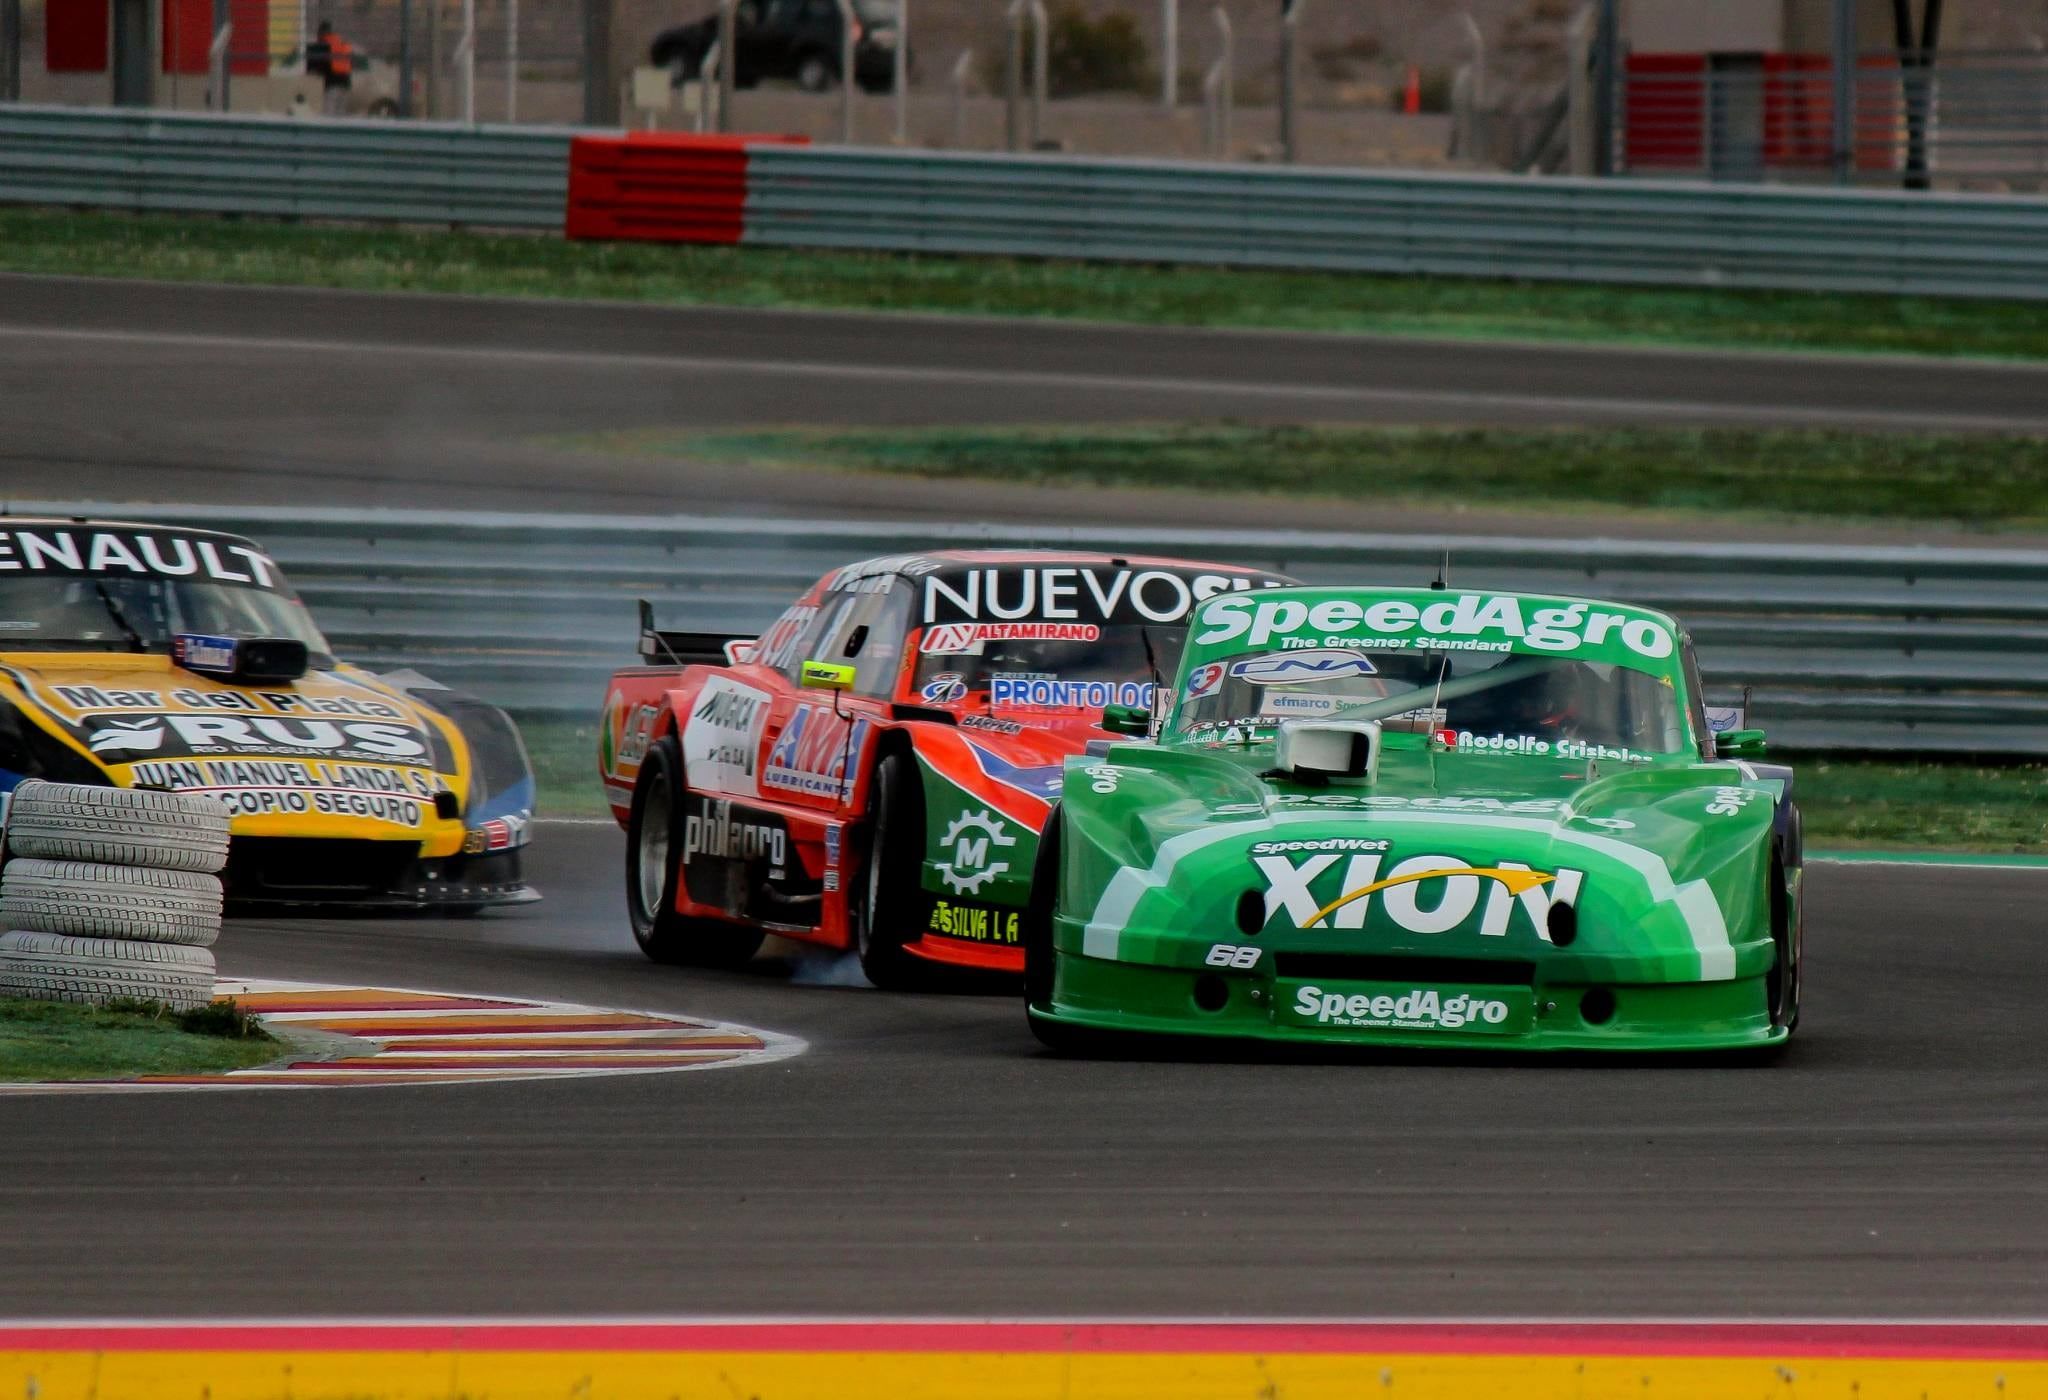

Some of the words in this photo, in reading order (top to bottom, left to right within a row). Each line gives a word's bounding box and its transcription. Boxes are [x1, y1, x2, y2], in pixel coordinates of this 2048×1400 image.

[975, 623, 1100, 641] ALTAMIRANO
[1194, 595, 1674, 659] SpeedAgro
[1281, 636, 1318, 649] The
[1324, 635, 1411, 649] Greener
[1414, 636, 1513, 653] Standard
[52, 686, 163, 708] Mar
[171, 688, 260, 711] del
[258, 691, 405, 719] Plata
[164, 716, 425, 756] RUS
[1457, 731, 1550, 753] Rodolfo
[132, 761, 205, 789] JUAN
[206, 761, 321, 787] MANUEL
[319, 764, 410, 794] LANDA
[204, 791, 306, 816] COPIO
[313, 791, 421, 827] SEGURO
[1253, 838, 1389, 855] SpeedWet
[1252, 854, 1584, 944] XION
[1204, 944, 1263, 969] 68
[1293, 986, 1509, 1028] SpeedAgro
[1333, 1017, 1350, 1025] The
[1352, 1017, 1390, 1026] Greener
[1391, 1019, 1436, 1028] Standard
